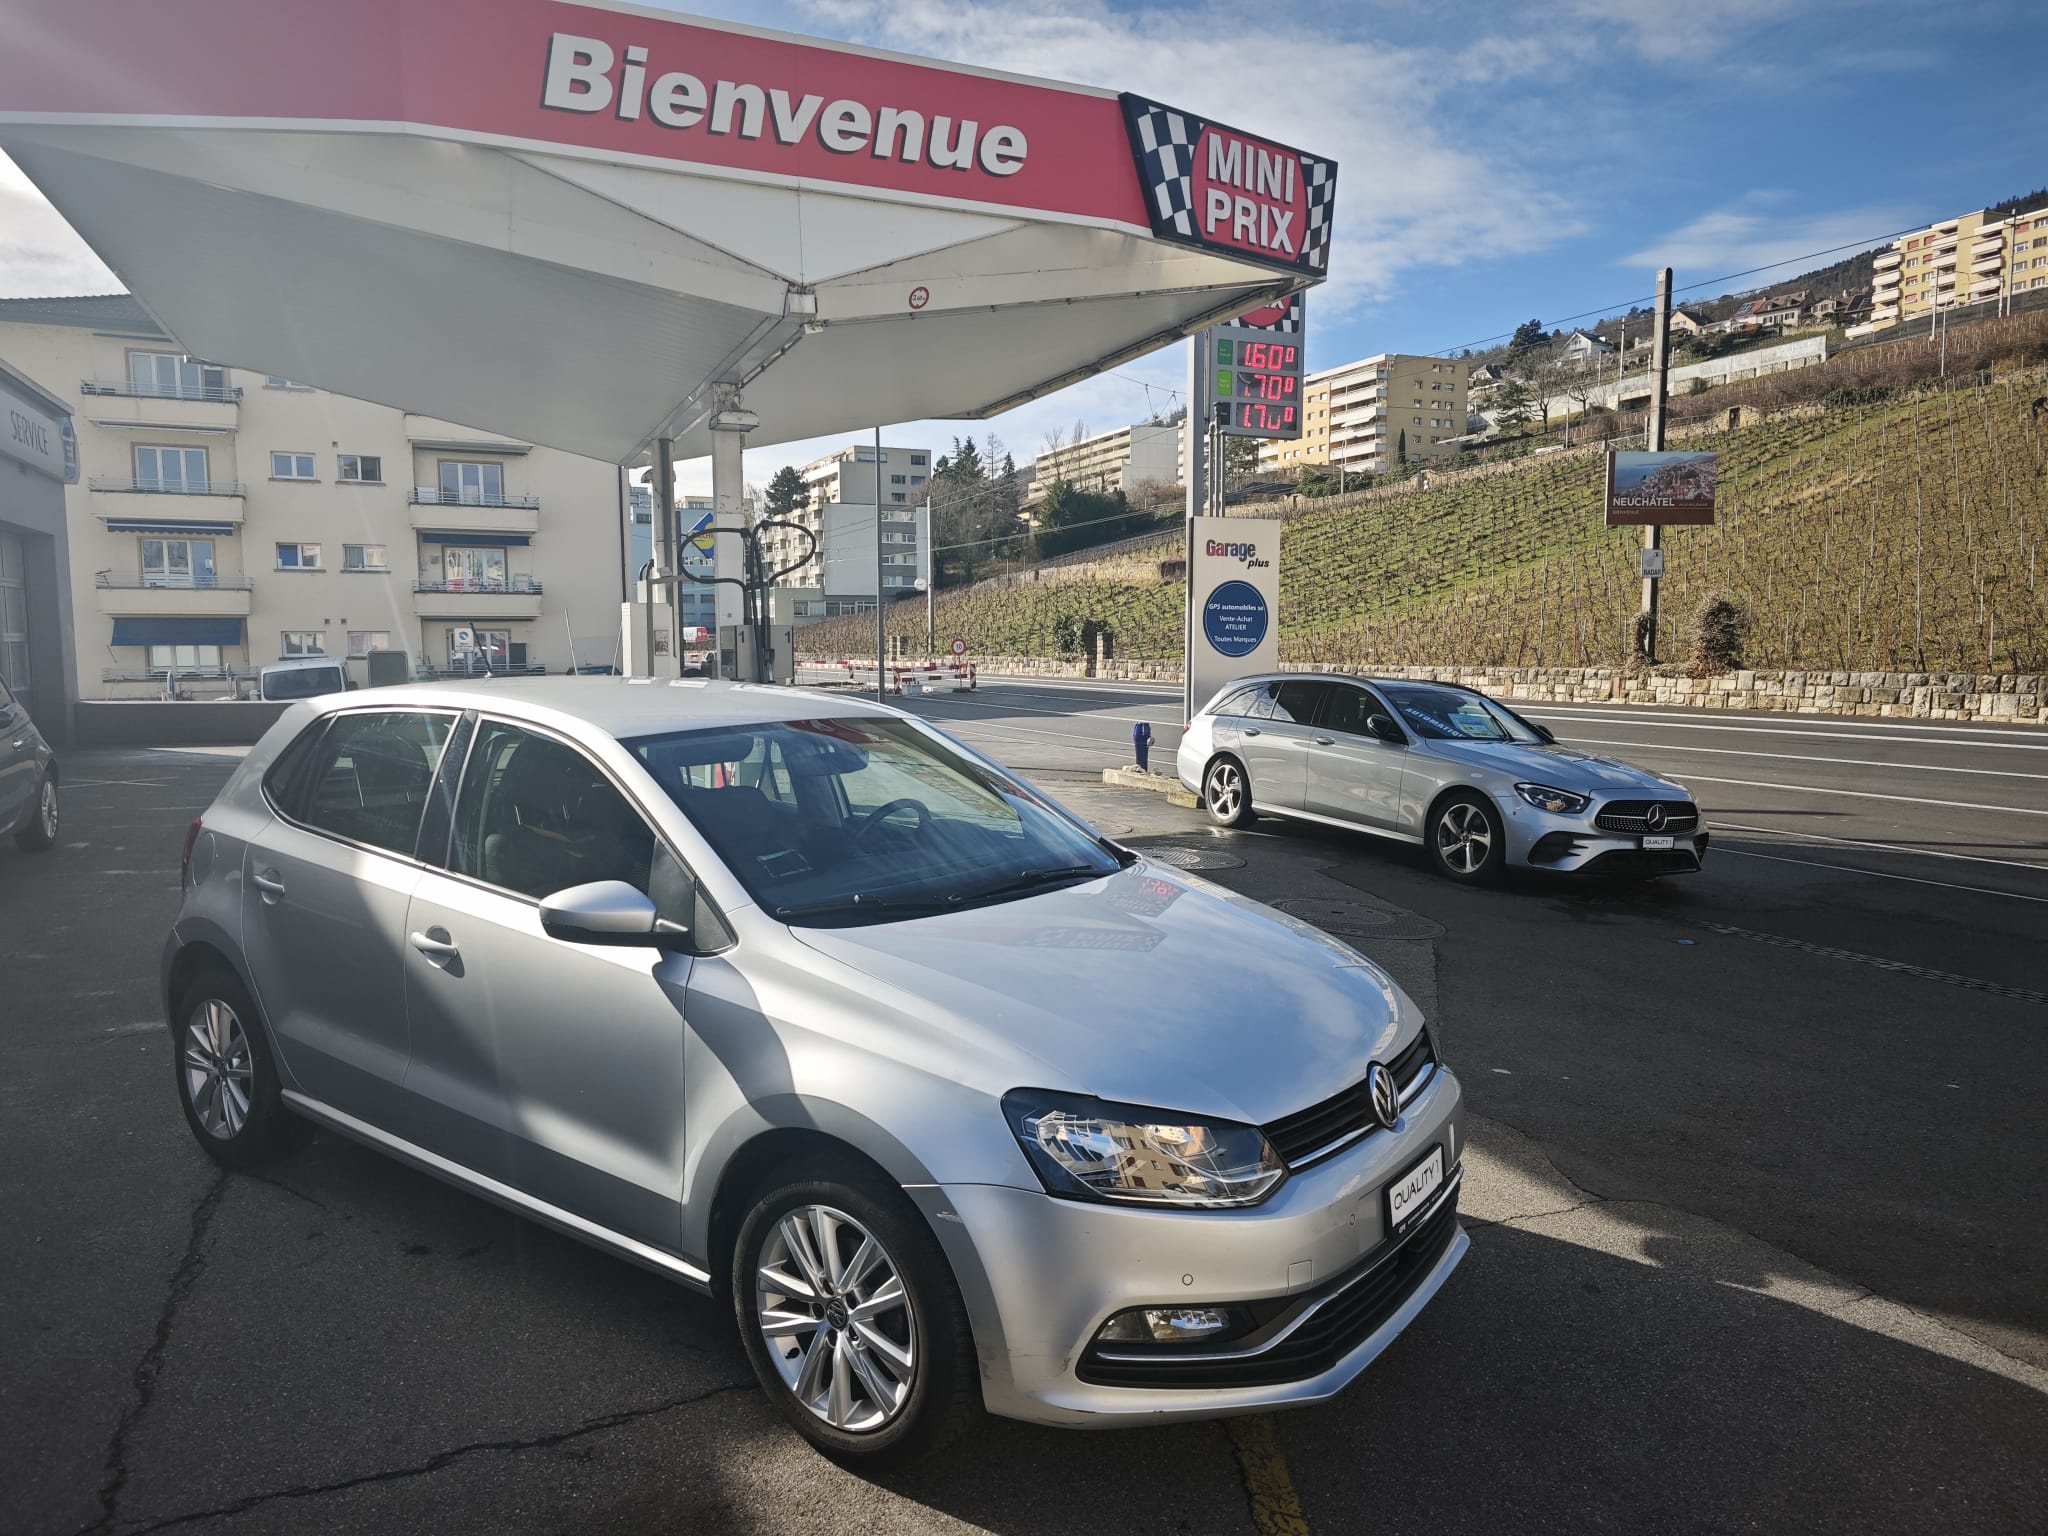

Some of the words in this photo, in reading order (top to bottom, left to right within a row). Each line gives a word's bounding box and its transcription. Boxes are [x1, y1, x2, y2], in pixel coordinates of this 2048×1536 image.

[541, 32, 1028, 176] Bienvenue
[1207, 132, 1295, 204] MINI
[1206, 187, 1294, 255] PRIX
[10, 408, 49, 456] SERVICE
[1612, 494, 1675, 507] NEUCHÂTEL
[1206, 539, 1256, 562] Garage
[1247, 557, 1270, 569] plus
[1219, 615, 1253, 623] Vente-Achat
[738, 631, 745, 644] 1
[784, 631, 791, 644] 1
[1214, 635, 1232, 643] Toutes
[1233, 635, 1257, 644] Marques
[1394, 1162, 1434, 1210] QUALITY
